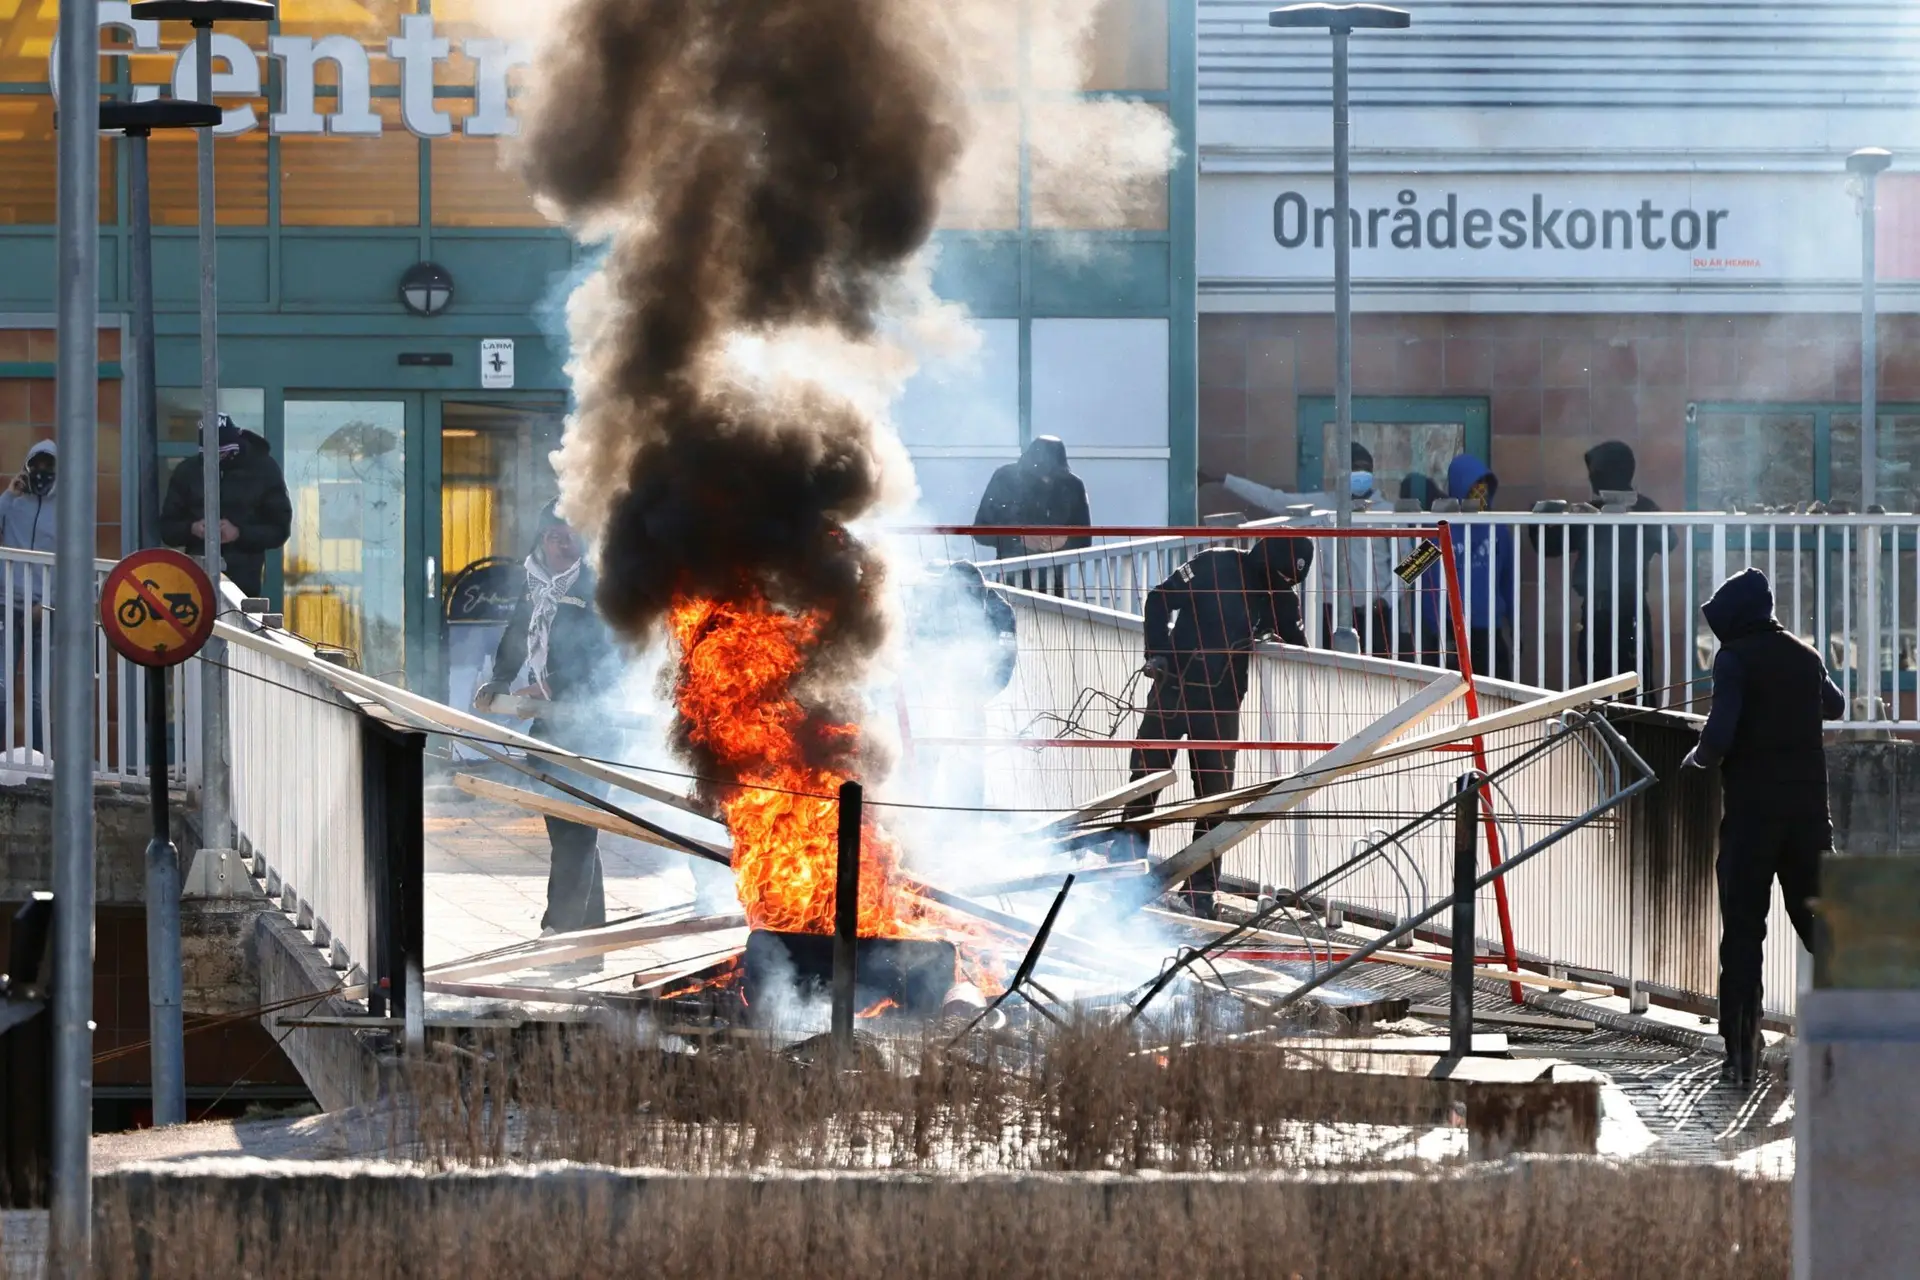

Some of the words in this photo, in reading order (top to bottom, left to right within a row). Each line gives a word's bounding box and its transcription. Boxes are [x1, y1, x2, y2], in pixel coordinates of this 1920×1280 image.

[1273, 189, 1729, 250] Områdeskontor
[1693, 258, 1707, 267] DU
[1725, 258, 1762, 268] HEMMA
